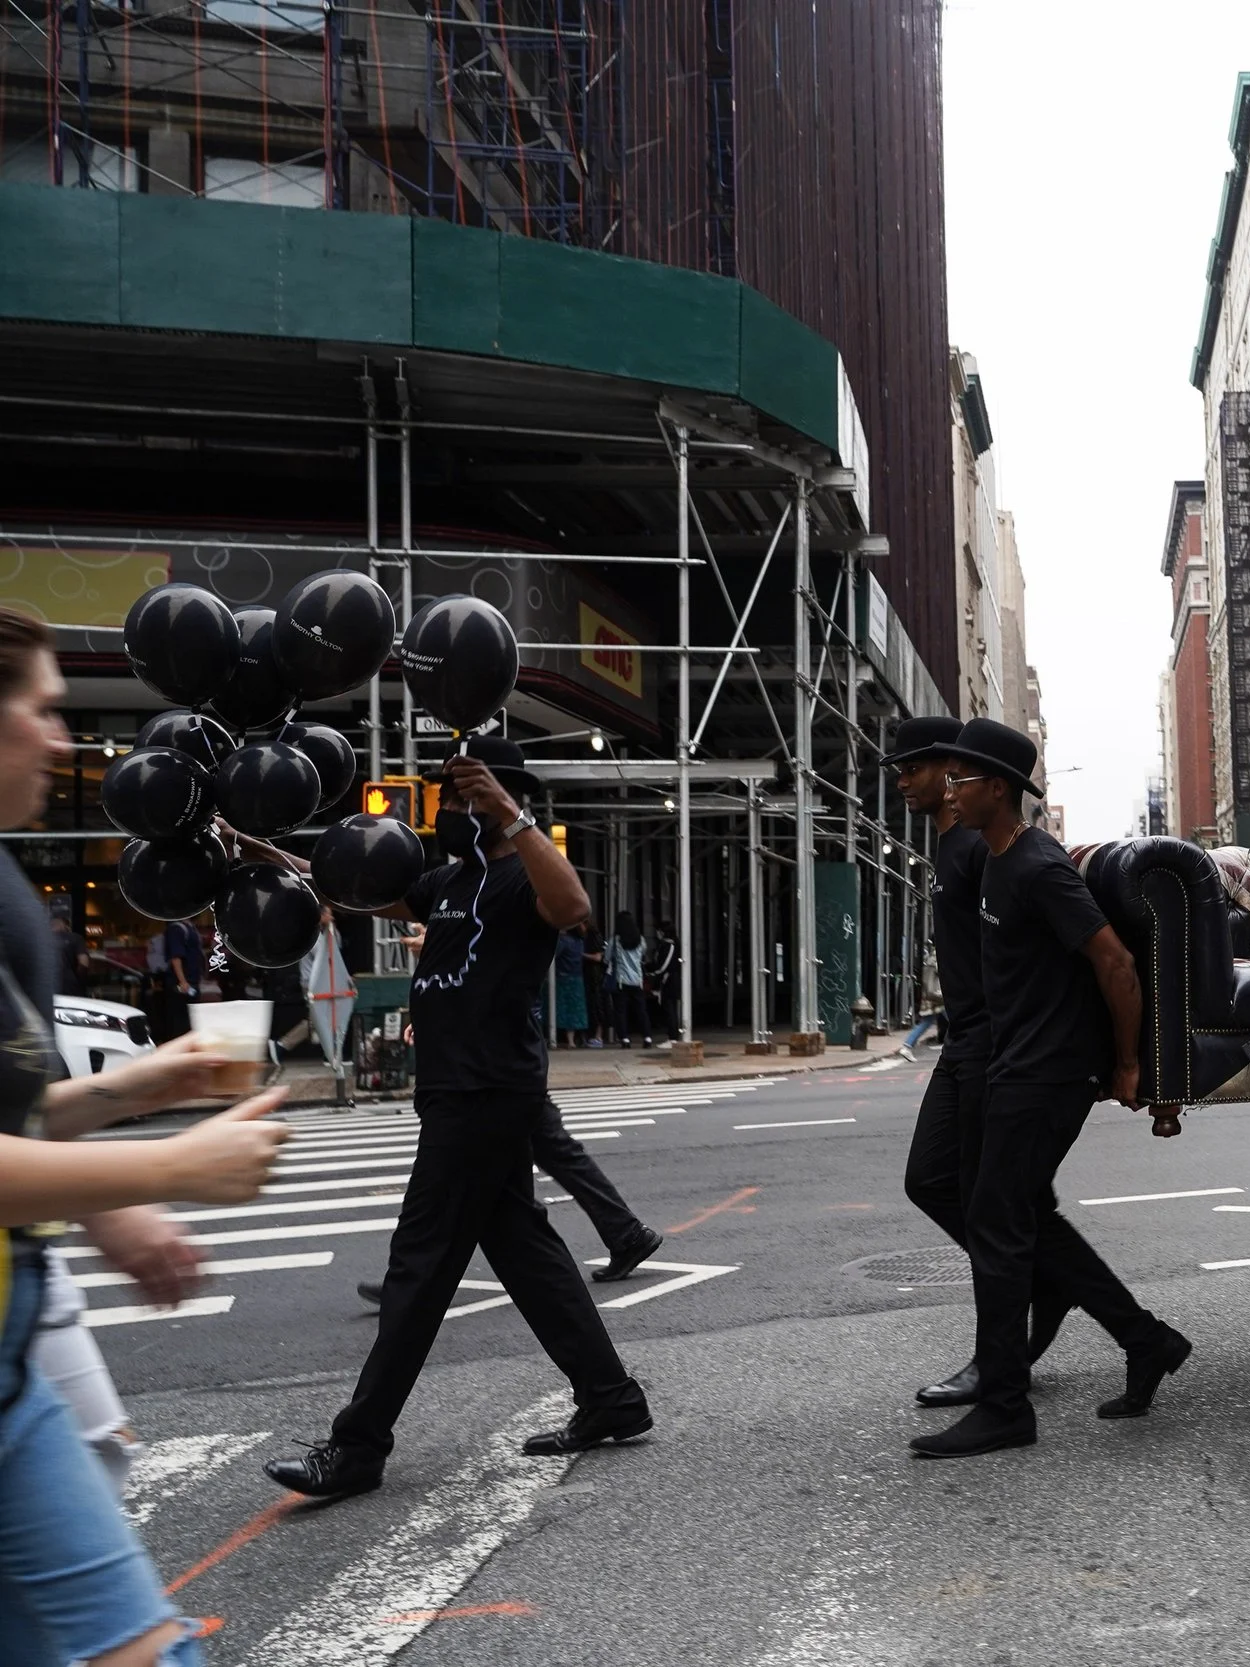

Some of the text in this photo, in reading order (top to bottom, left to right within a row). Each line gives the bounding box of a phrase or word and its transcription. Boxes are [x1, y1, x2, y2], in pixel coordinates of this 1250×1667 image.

[290, 617, 344, 652] TIMOTHY OULTON
[239, 656, 259, 665] LTON
